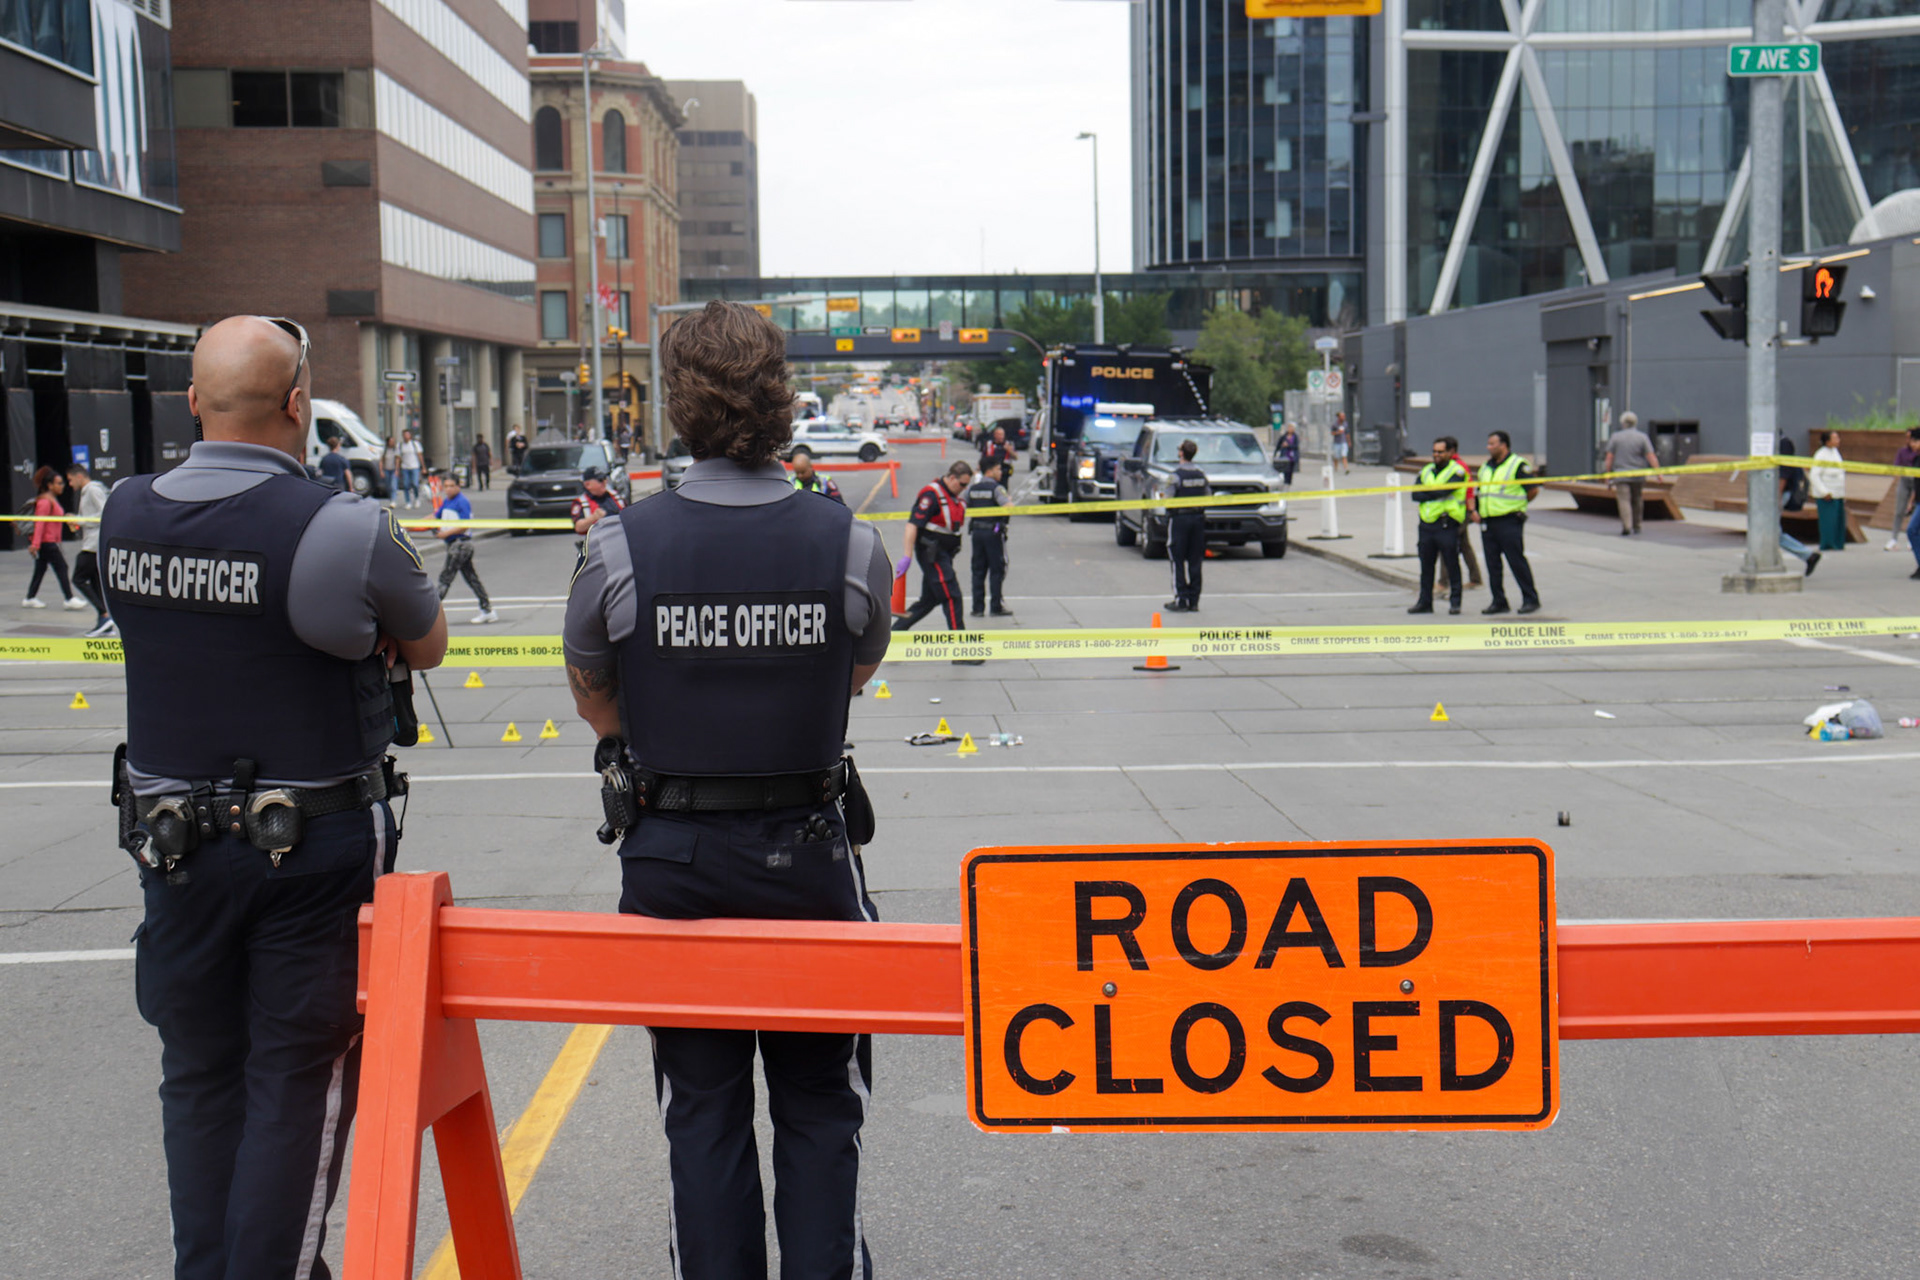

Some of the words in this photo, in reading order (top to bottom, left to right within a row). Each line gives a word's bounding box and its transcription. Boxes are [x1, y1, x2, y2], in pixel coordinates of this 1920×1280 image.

[1739, 49, 1751, 70] 7
[1757, 48, 1790, 70] AVE
[1798, 47, 1810, 70] S
[1091, 366, 1154, 379] POLICE
[108, 547, 162, 596] PEACE
[167, 556, 259, 604] OFFICER
[656, 604, 729, 647] PEACE
[734, 603, 826, 647] OFFICER
[1790, 622, 1835, 632] POLICE
[1838, 621, 1866, 630] LINE
[1199, 630, 1242, 641] POLICE
[1246, 629, 1273, 641] LINE
[1491, 626, 1535, 638] POLICE
[1539, 626, 1566, 637] LINE
[1584, 633, 1614, 641] CRIME
[1618, 632, 1667, 641] STOPPERS
[913, 633, 955, 645] POLICE
[959, 633, 985, 644] LINE
[1003, 640, 1031, 649] CRIME
[1034, 640, 1081, 649] STOPPERS
[1084, 639, 1160, 648] 1-800-222-8477
[1290, 637, 1320, 645] CRIME
[1323, 636, 1371, 645] STOPPERS
[1374, 635, 1451, 644] 1-800-222-8477
[1484, 639, 1501, 647] DO
[1505, 639, 1529, 647] NOT
[1534, 638, 1576, 646] CROSS
[474, 647, 519, 656] STOPPERS
[522, 646, 564, 655] 1-800-22
[905, 647, 922, 658] DO
[925, 647, 949, 658] NOT
[952, 646, 993, 657] CROSS
[1191, 643, 1208, 653] DO
[1212, 643, 1236, 652] NOT
[1240, 642, 1281, 652] CROSS
[82, 652, 99, 661] DO
[102, 652, 124, 662] NOT
[1073, 876, 1434, 972] ROAD
[1003, 1000, 1514, 1096] CLOSED
